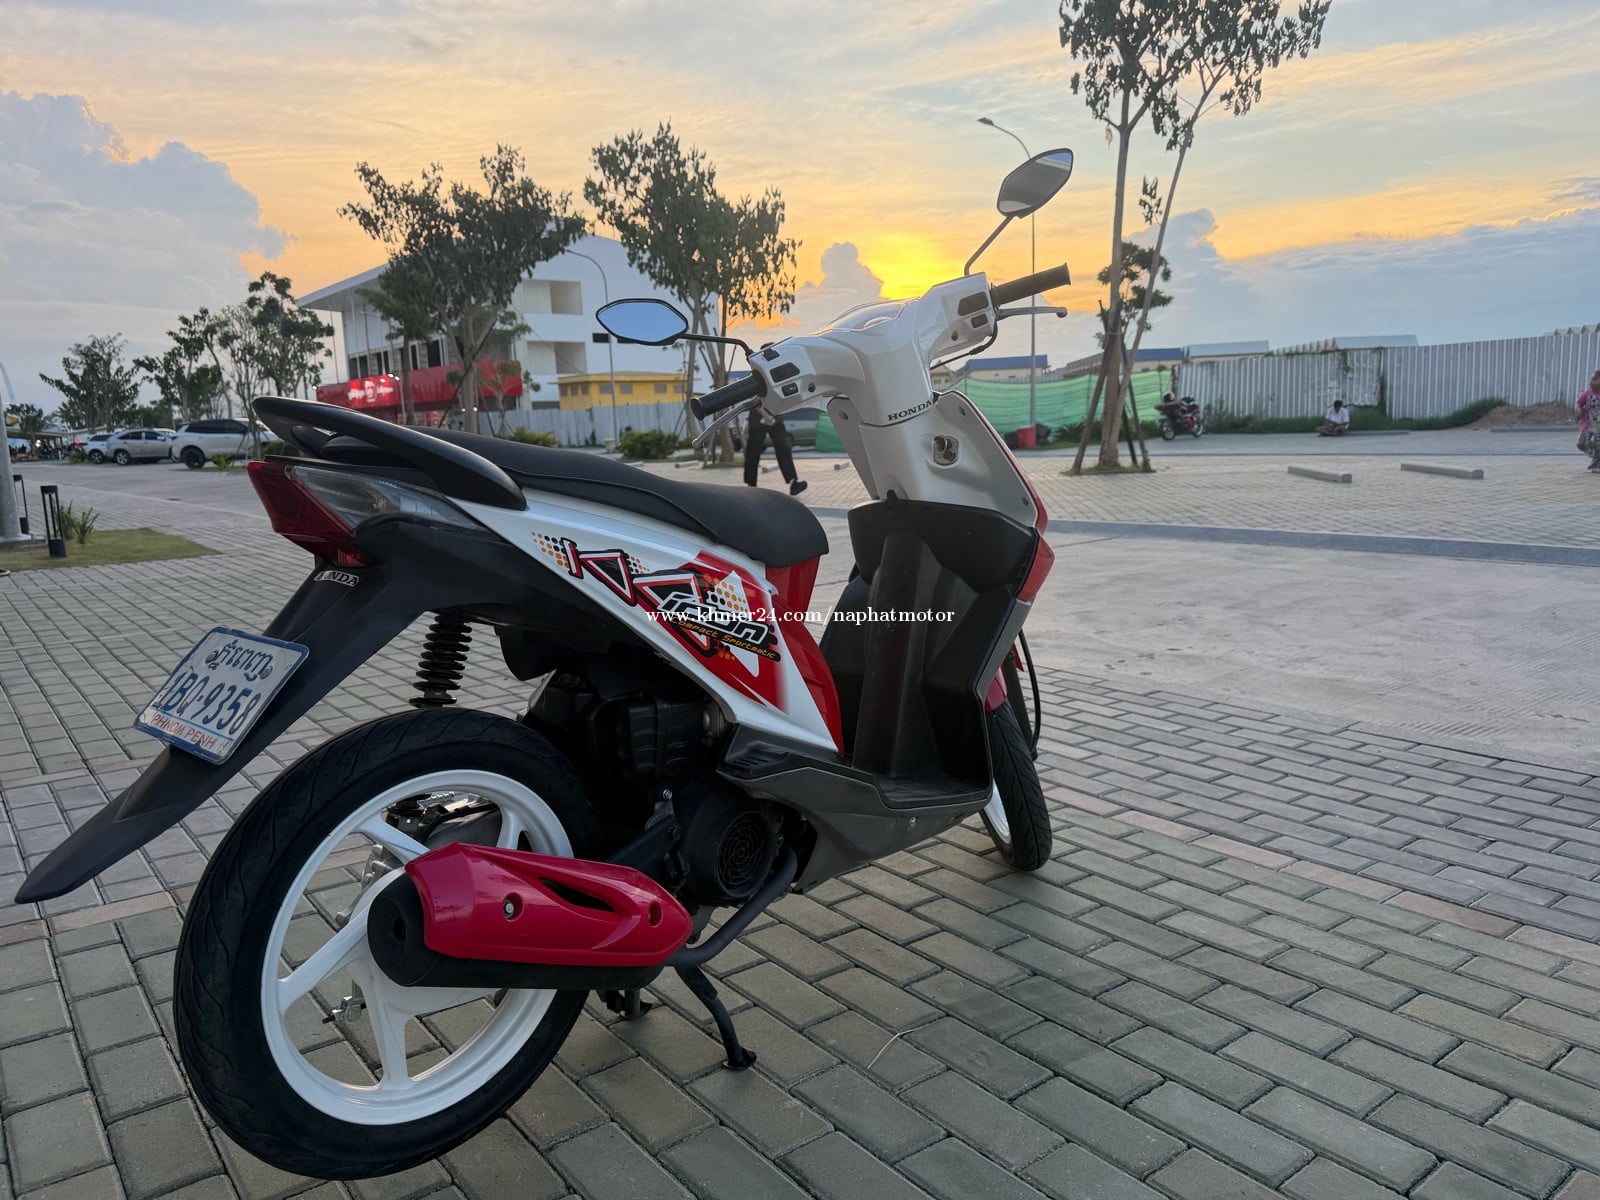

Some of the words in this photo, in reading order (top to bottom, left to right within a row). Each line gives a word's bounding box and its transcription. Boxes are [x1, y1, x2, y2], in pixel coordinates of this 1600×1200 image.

[887, 400, 933, 421] HONDA
[153, 713, 184, 736] PHNOM
[184, 727, 218, 749] PENH
